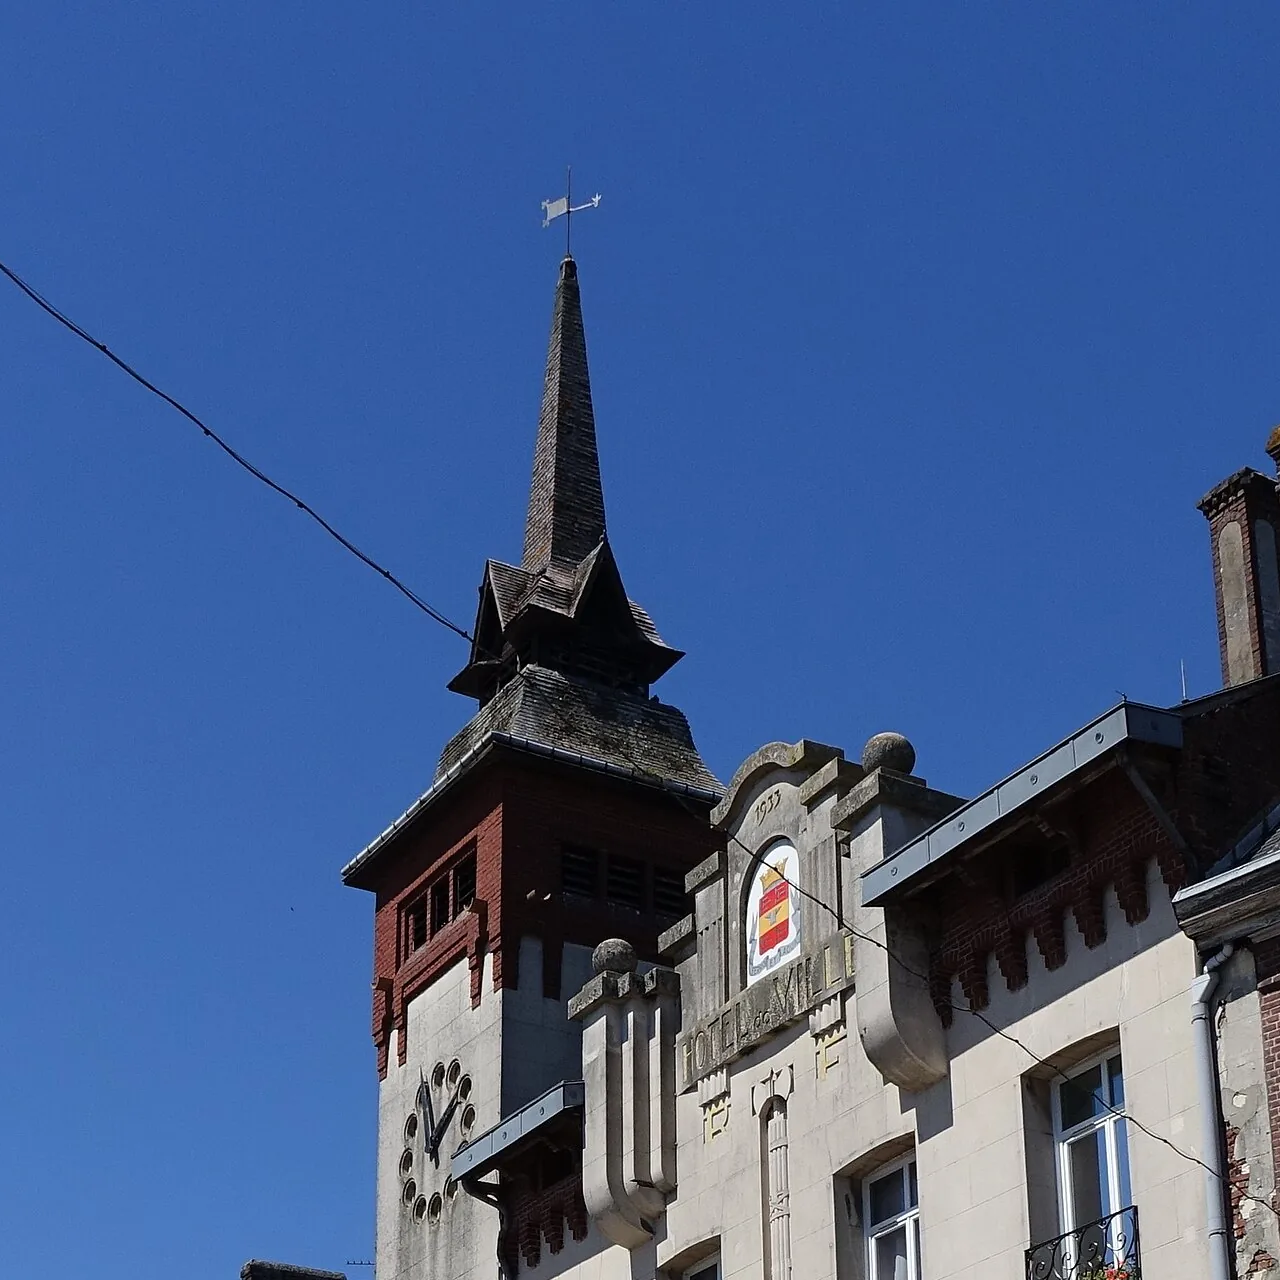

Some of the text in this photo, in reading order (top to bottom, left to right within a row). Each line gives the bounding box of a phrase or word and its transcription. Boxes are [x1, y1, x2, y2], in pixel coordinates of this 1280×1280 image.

[754, 789, 781, 826] 1933
[682, 1002, 749, 1083] HOTEL
[772, 932, 856, 1012] VILLE
